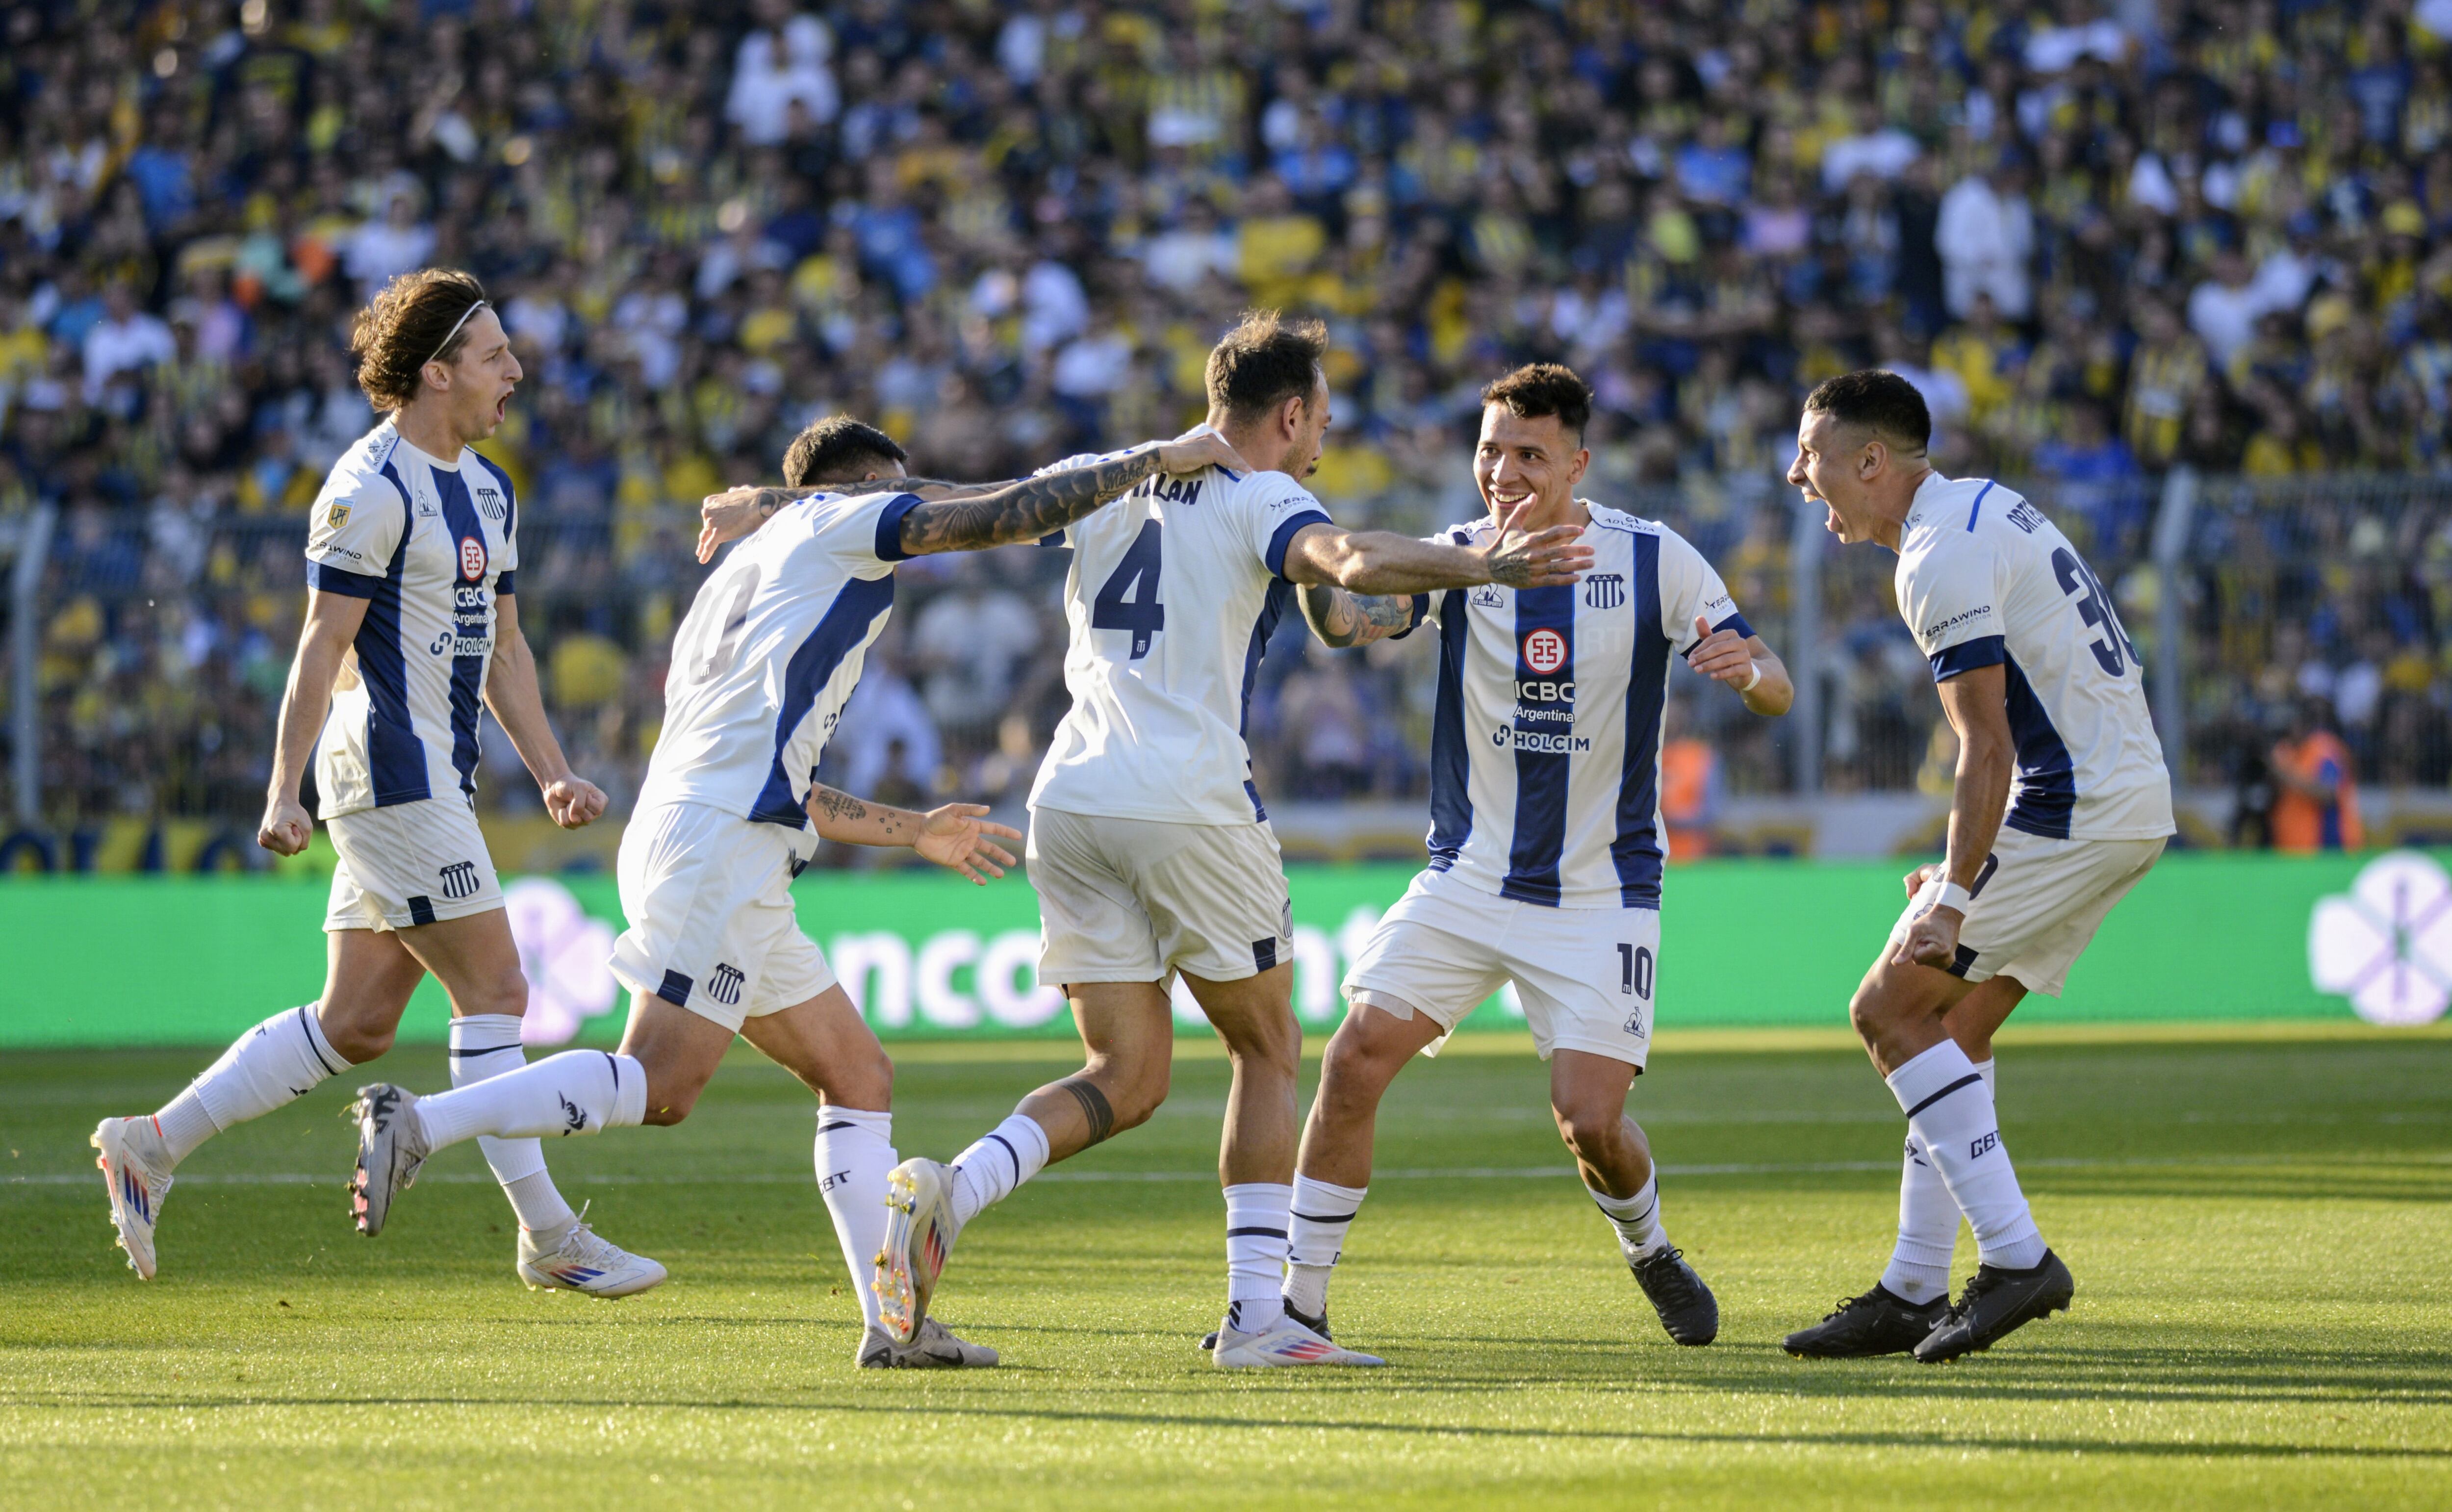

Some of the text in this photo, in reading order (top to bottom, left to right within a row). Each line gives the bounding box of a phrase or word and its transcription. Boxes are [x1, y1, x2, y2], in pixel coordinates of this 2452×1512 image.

[373, 437, 395, 467] ADVANTA
[1098, 457, 1148, 497] Mabel
[1604, 518, 1655, 532] ADVANTA
[452, 587, 488, 608] ICBC
[1091, 518, 1165, 660] 4
[452, 612, 488, 626] Argentina
[1925, 605, 1991, 637] ERRAWIND
[454, 639, 492, 654] HOLCIM
[1514, 680, 1576, 703] ICBC
[1513, 706, 1575, 723] Argentina
[1514, 733, 1590, 752] HOLCIM
[447, 863, 465, 872] C.A.T
[723, 965, 740, 976] C.A.T
[1617, 943, 1653, 1001] 10
